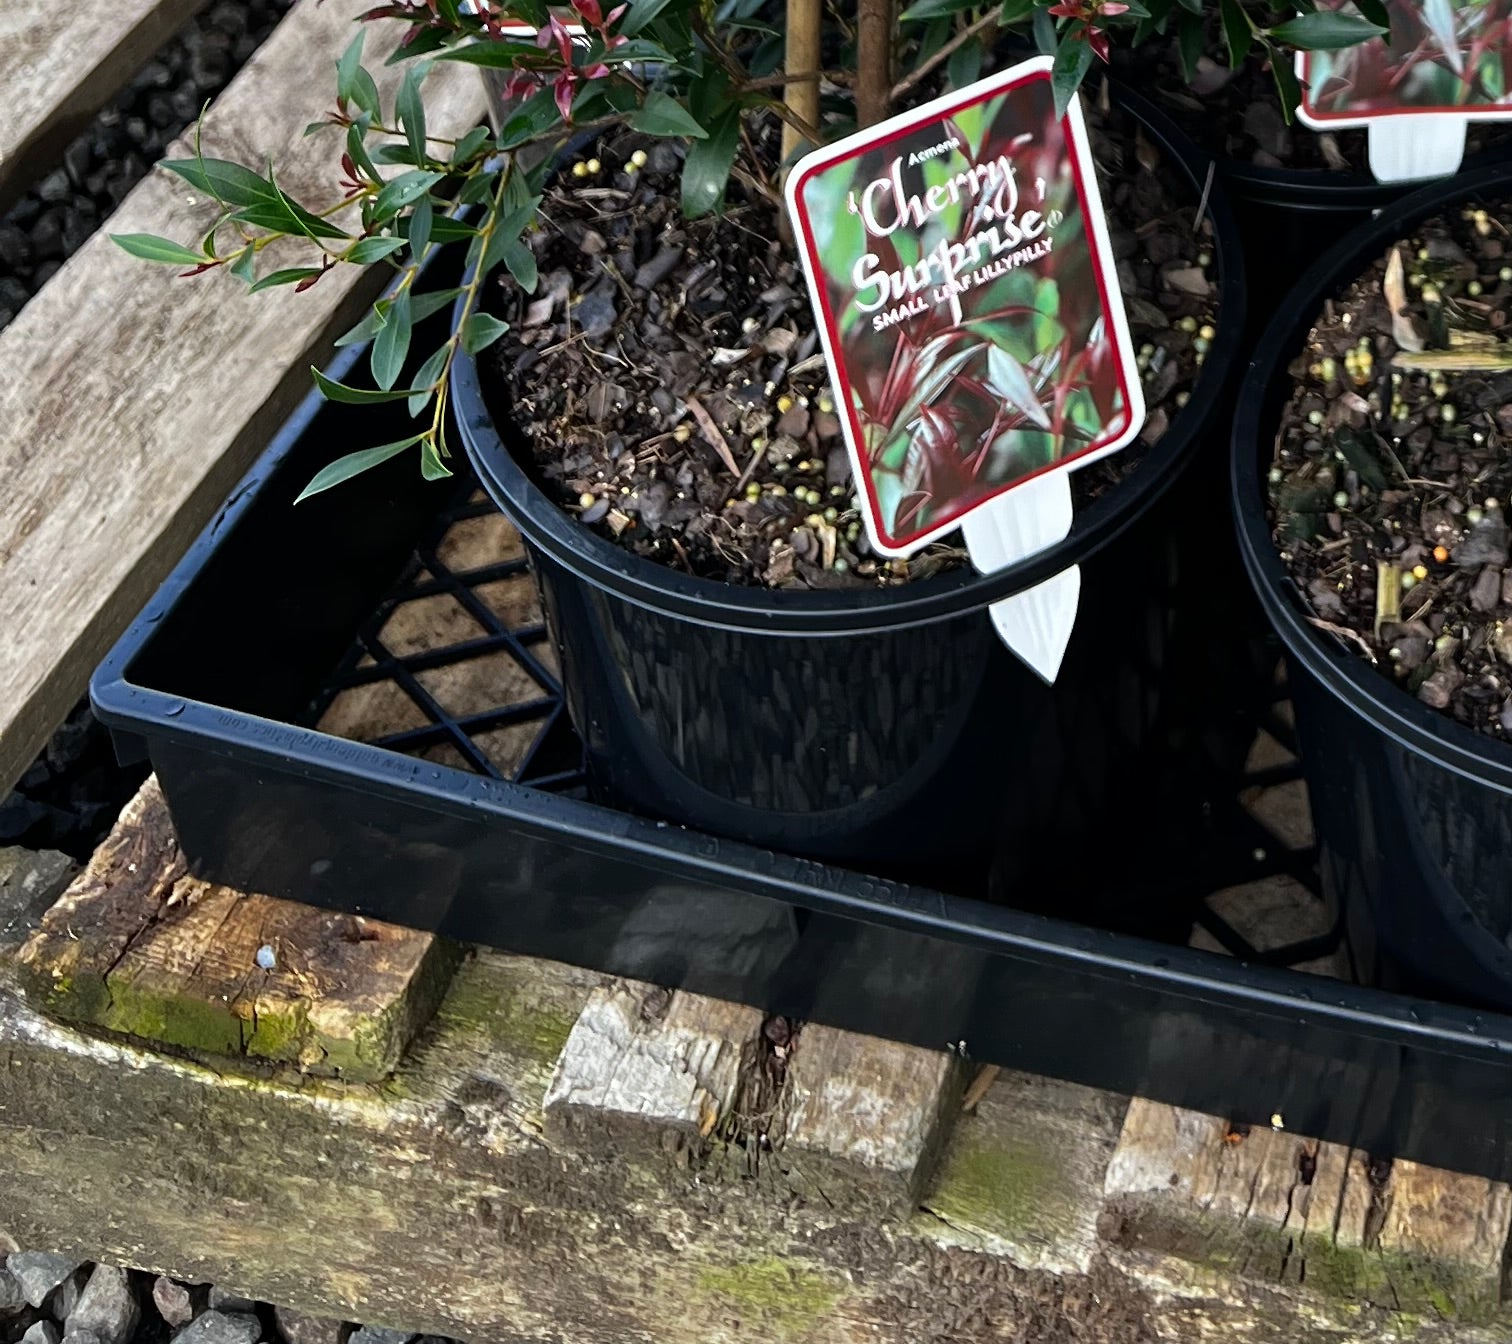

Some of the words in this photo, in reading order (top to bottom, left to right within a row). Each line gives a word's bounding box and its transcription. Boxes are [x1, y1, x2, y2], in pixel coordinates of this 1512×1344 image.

[908, 137, 960, 167] Acmena
[872, 296, 930, 333] SMALL
[933, 274, 972, 303] LEAF
[973, 236, 1054, 287] LILLYPILLY
